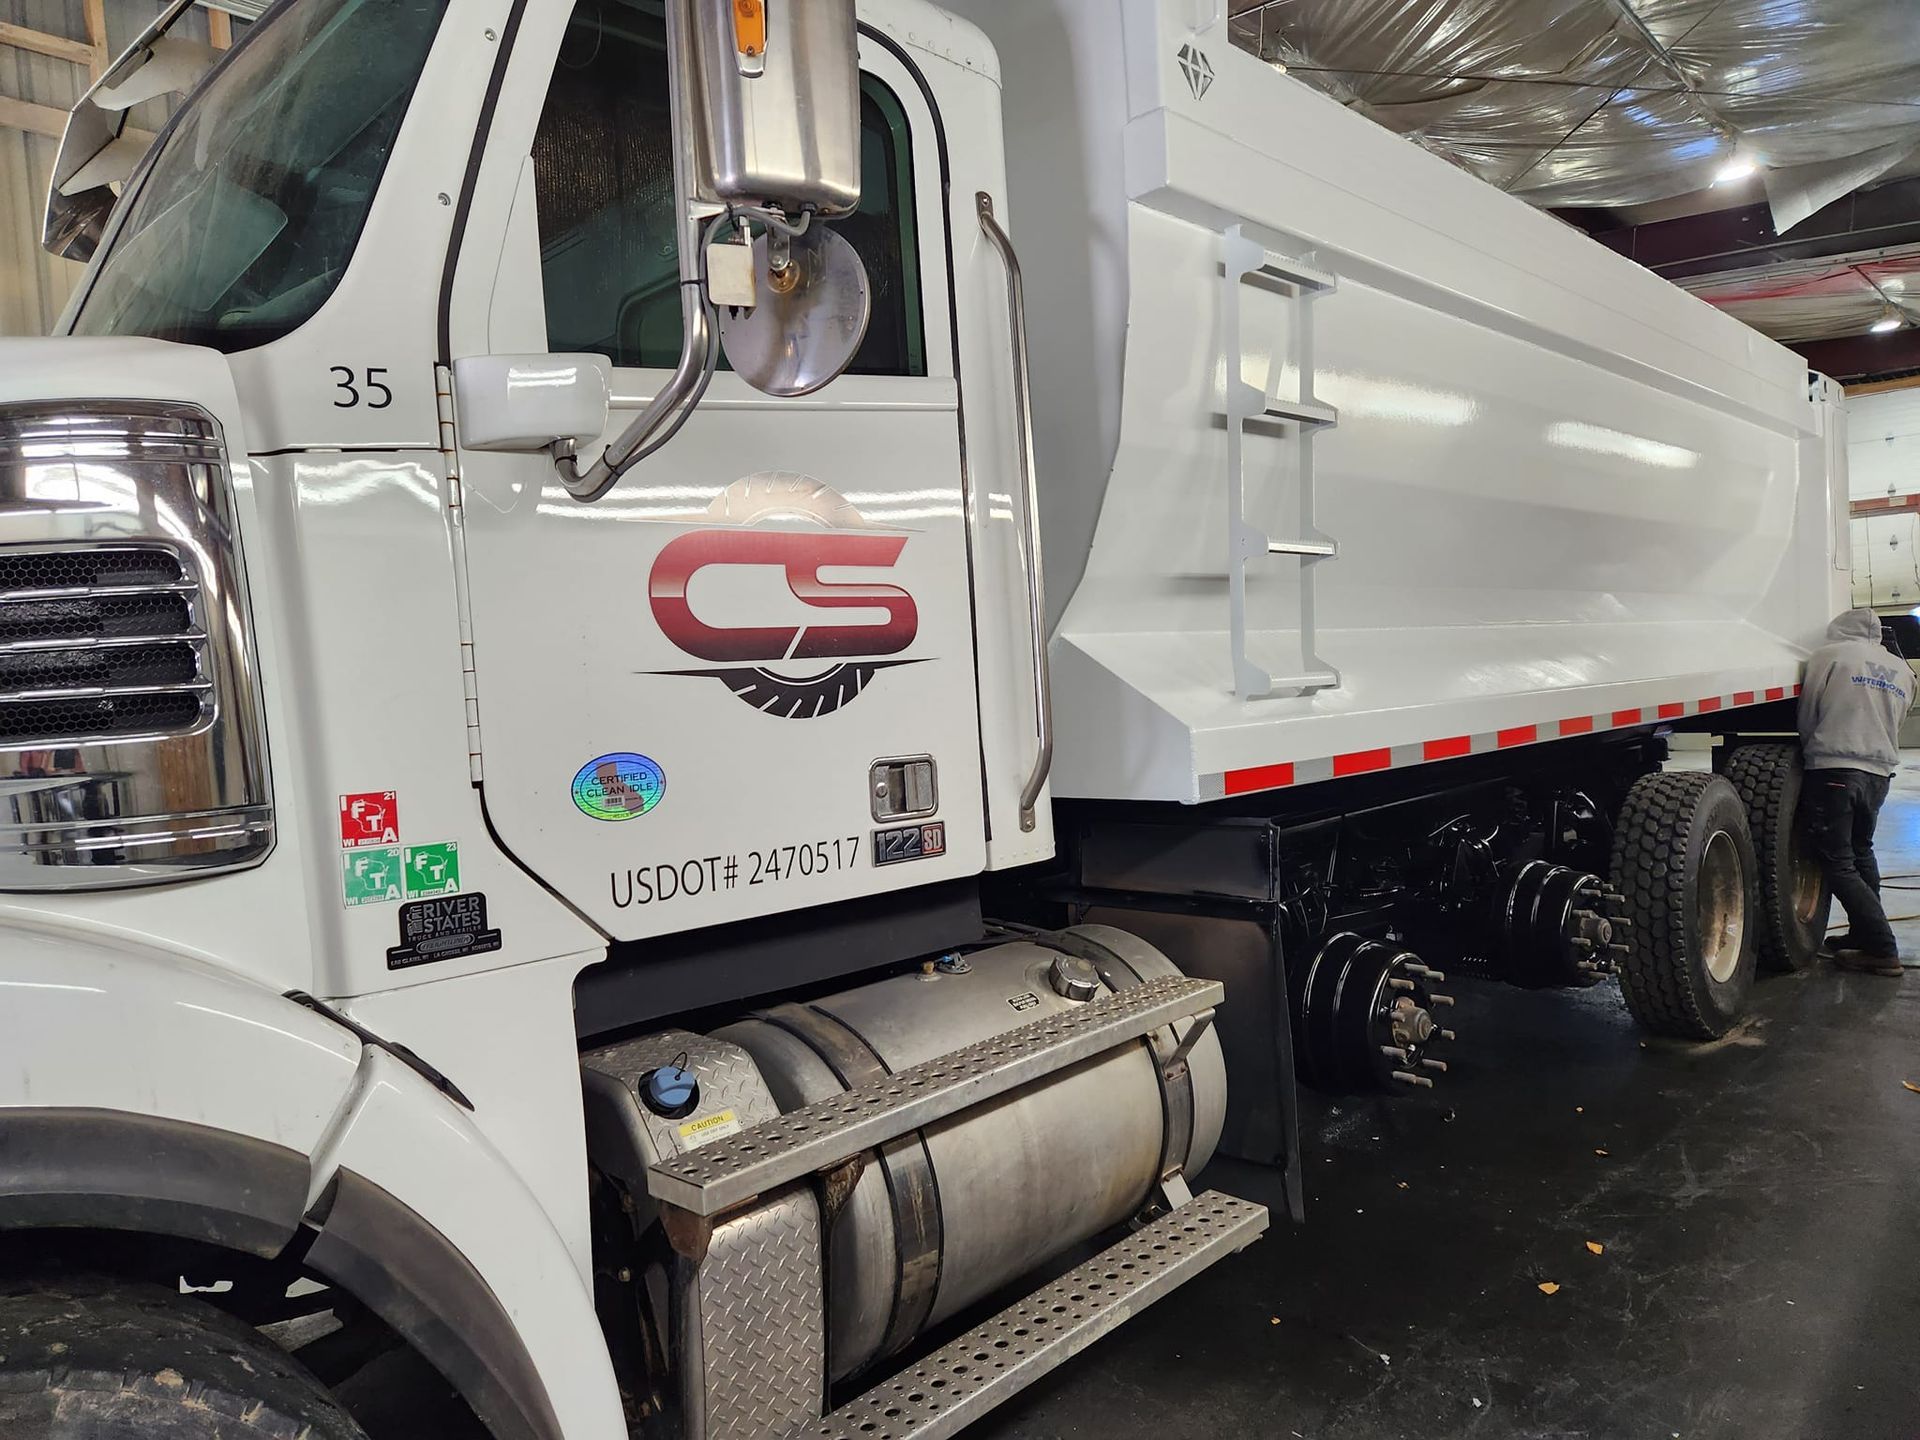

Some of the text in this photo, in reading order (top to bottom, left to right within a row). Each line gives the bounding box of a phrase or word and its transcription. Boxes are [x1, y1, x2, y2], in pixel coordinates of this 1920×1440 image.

[329, 366, 392, 409] 35
[648, 529, 919, 662] CS
[591, 772, 648, 786] CERTIFIED
[384, 792, 395, 801] 21
[586, 782, 653, 798] CLEAN IDLE
[342, 838, 355, 848] WI
[923, 823, 943, 852] SD
[386, 848, 399, 857] 20
[446, 843, 457, 852] 23
[610, 836, 860, 909] USDOT# 2470517
[423, 896, 480, 919] RIVER
[423, 910, 481, 933] STATES
[691, 1115, 724, 1131] CAUTION
